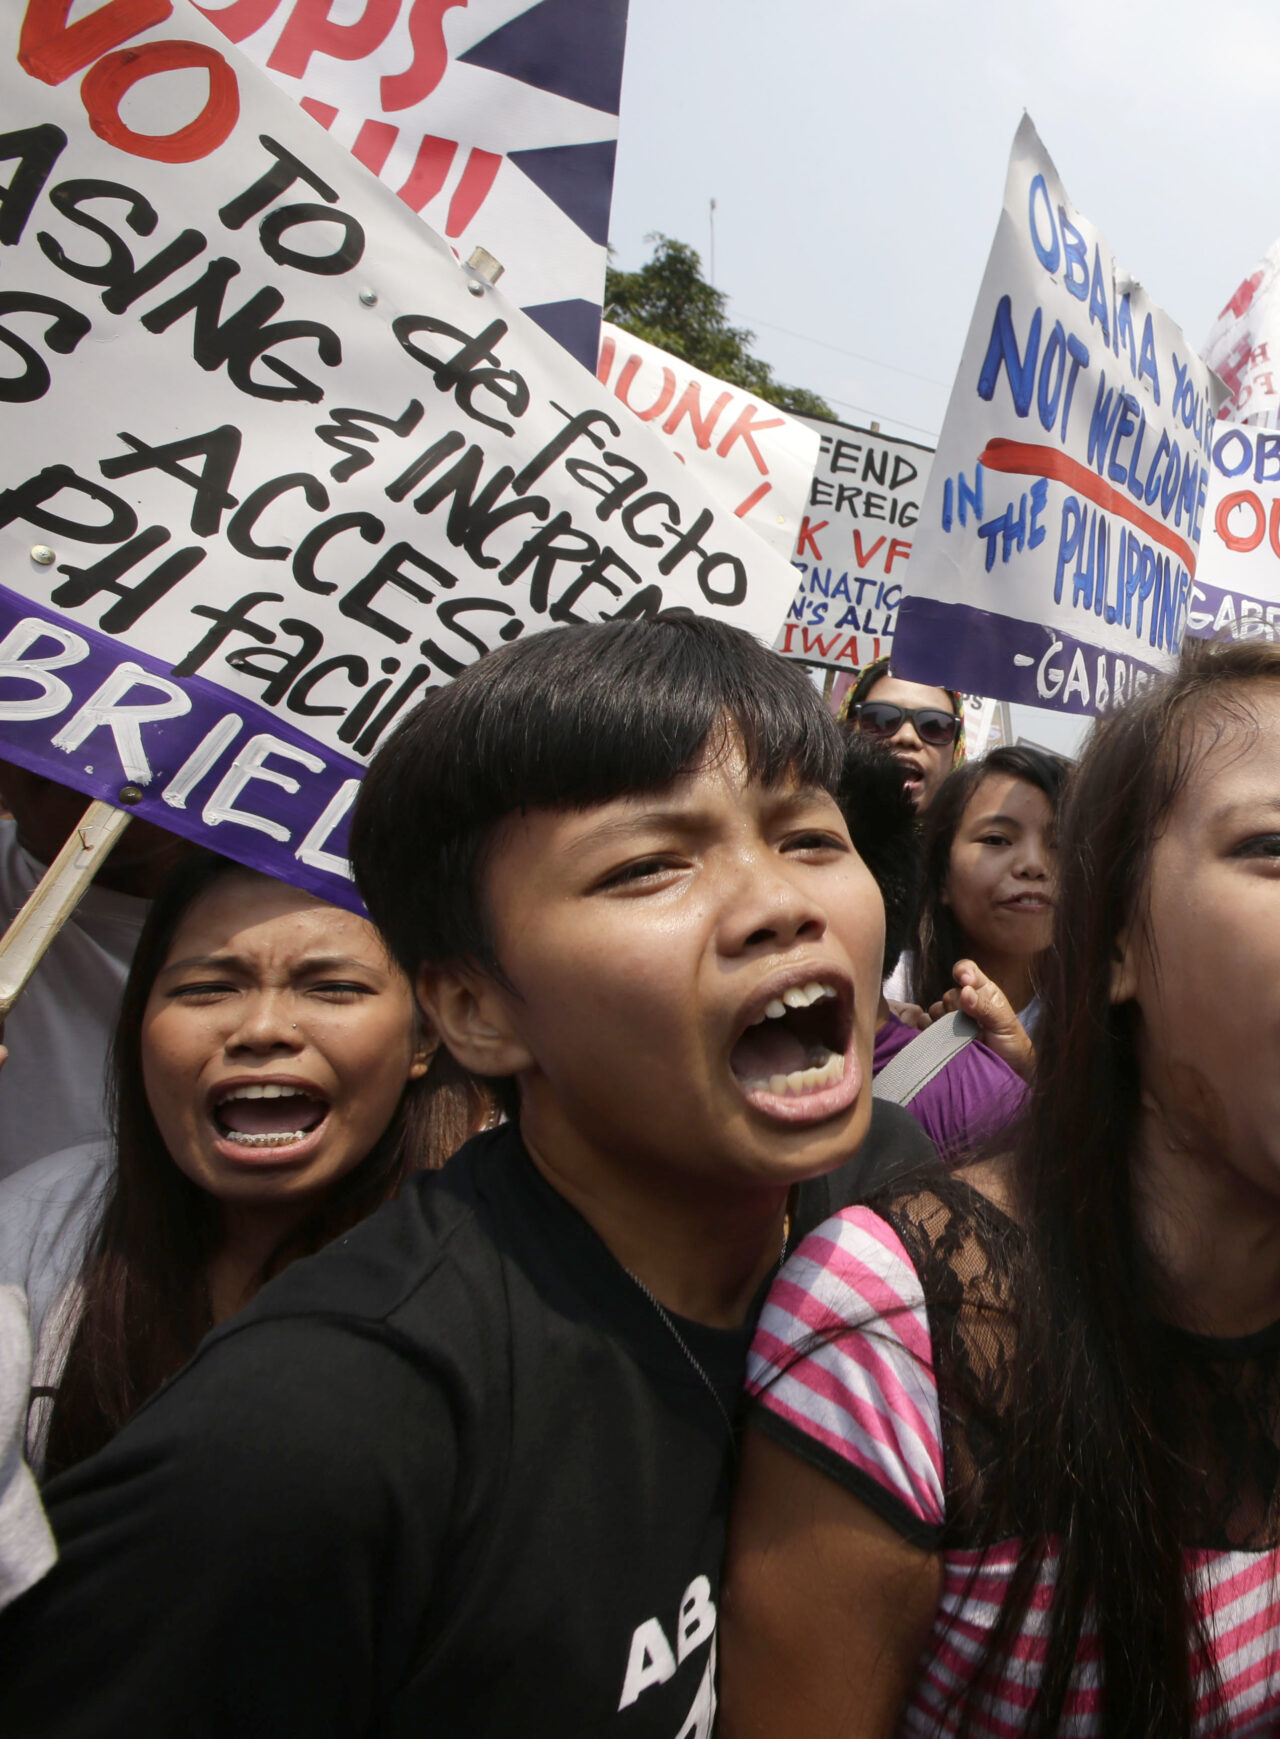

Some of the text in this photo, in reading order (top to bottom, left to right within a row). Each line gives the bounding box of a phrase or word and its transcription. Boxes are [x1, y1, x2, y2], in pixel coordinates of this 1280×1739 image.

[219, 134, 365, 275] TO
[392, 315, 529, 437] de
[512, 401, 747, 607] facto
[1028, 173, 1161, 407] OBAMA
[809, 477, 920, 528] EREIG
[977, 295, 1089, 443] NOT
[1087, 370, 1208, 541] WELCOME
[797, 516, 912, 575] K VF
[941, 463, 984, 533] IN
[977, 477, 1048, 573] THE
[0, 618, 356, 882] BRIEL
[172, 593, 440, 758] facil
